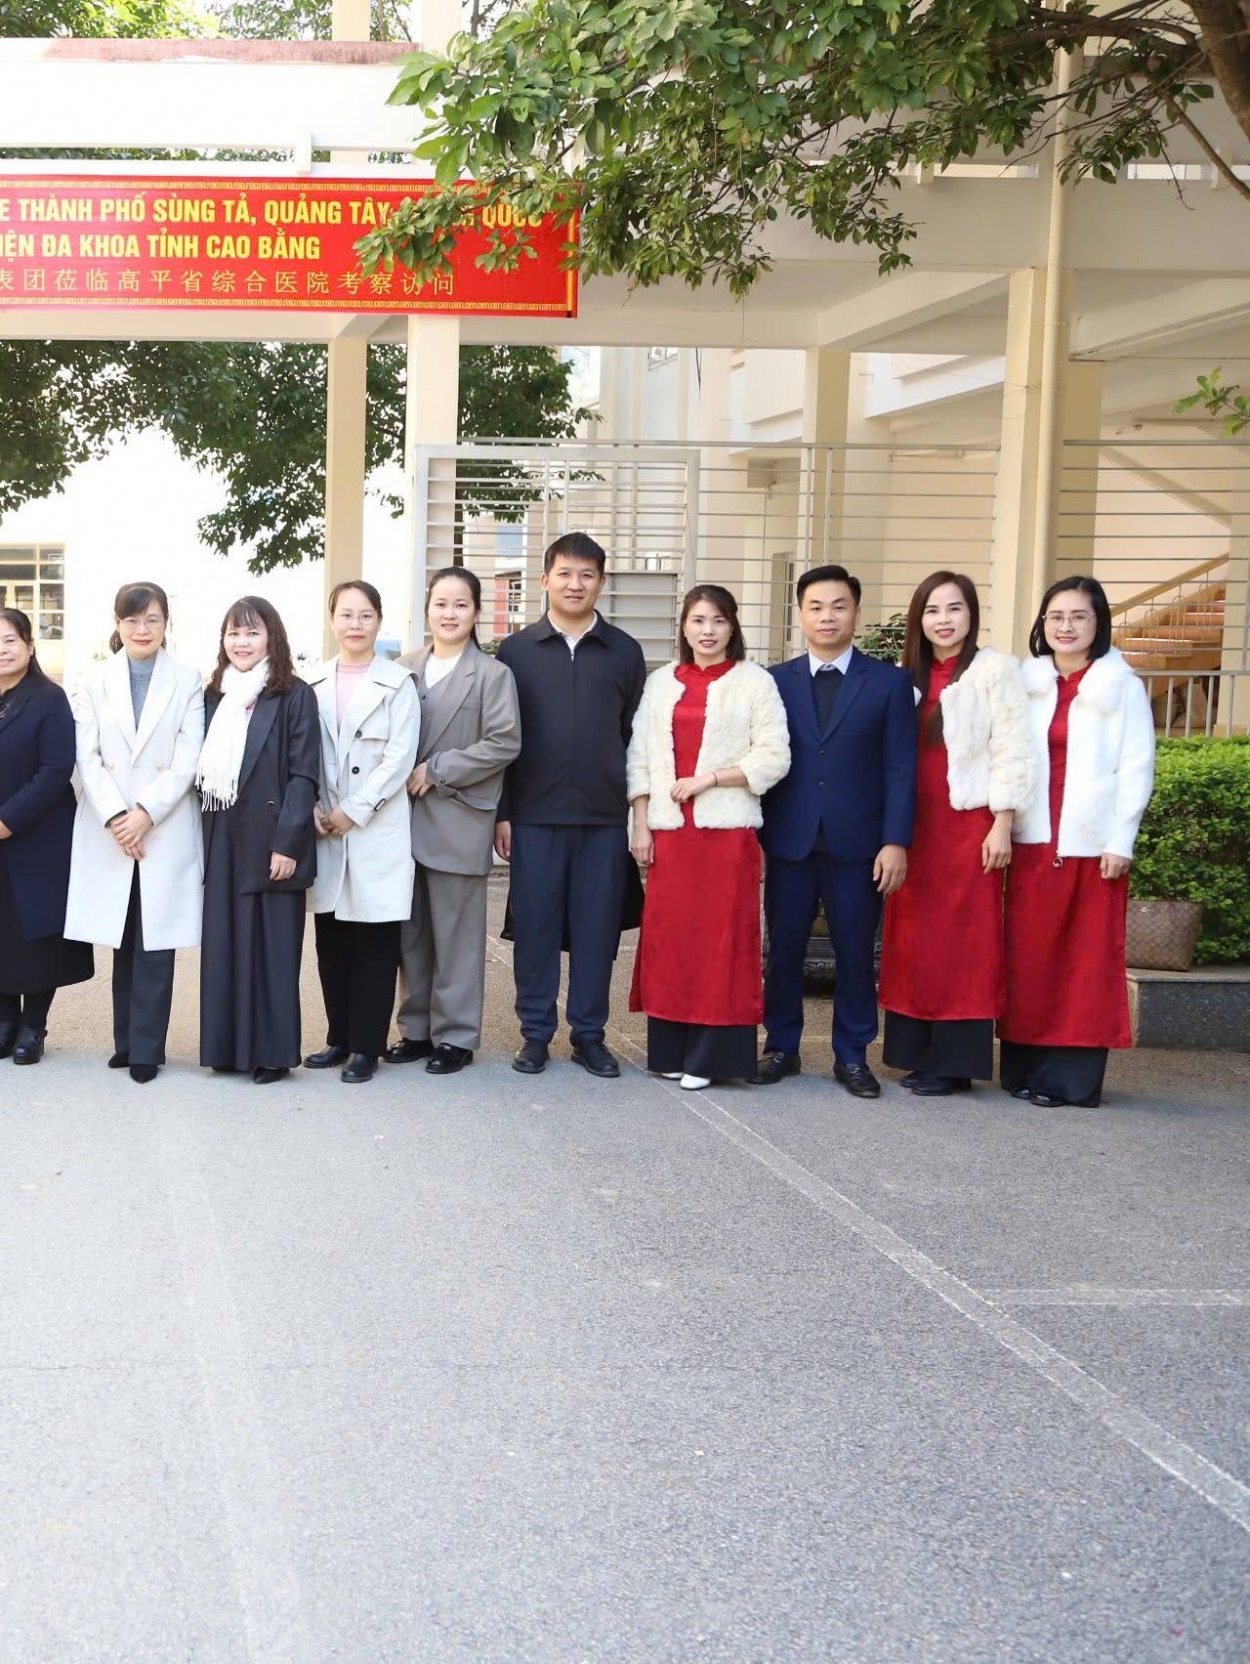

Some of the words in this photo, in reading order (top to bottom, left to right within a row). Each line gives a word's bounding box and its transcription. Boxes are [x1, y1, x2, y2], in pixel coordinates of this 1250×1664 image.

[17, 193, 93, 222] THÀNH
[100, 191, 147, 223] PHỐ
[152, 192, 216, 223] SÙNG
[222, 192, 257, 226] TẢ,
[264, 193, 342, 226] QUẢNG
[41, 234, 73, 258] ĐA
[79, 234, 141, 258] KHOA
[147, 227, 199, 258] TỈNH
[206, 235, 251, 259] CAO
[257, 227, 320, 259] BẰNG
